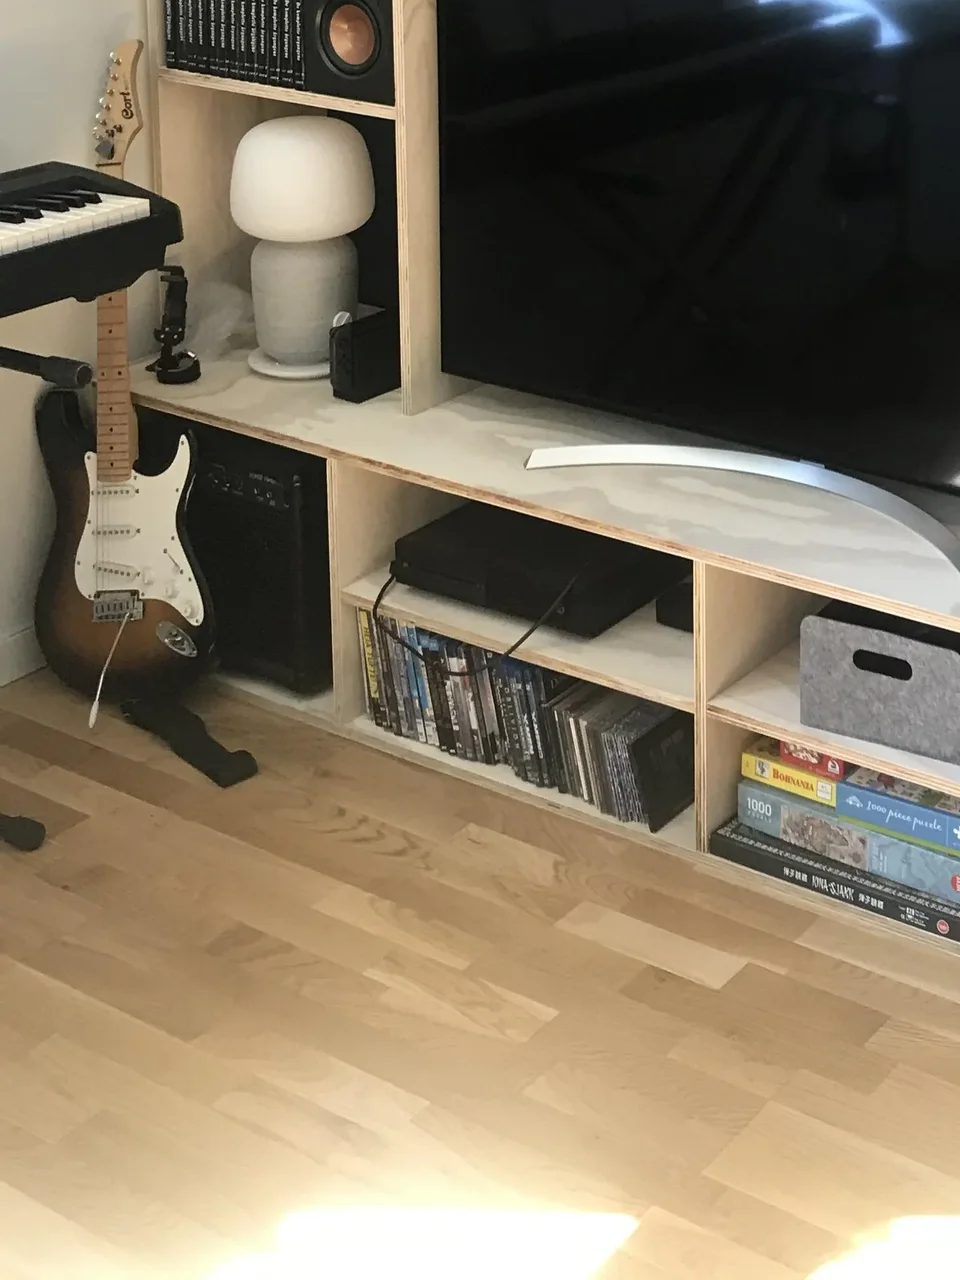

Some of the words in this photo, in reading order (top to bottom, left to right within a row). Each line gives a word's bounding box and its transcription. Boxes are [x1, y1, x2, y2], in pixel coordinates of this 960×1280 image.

[120, 91, 134, 119] Cort
[504, 687, 520, 749] OBLIVION
[772, 768, 814, 793] BOHNANZA
[747, 797, 772, 816] 1000
[867, 801, 887, 813] 1000
[886, 809, 912, 823] piece
[912, 816, 943, 831] puzzle
